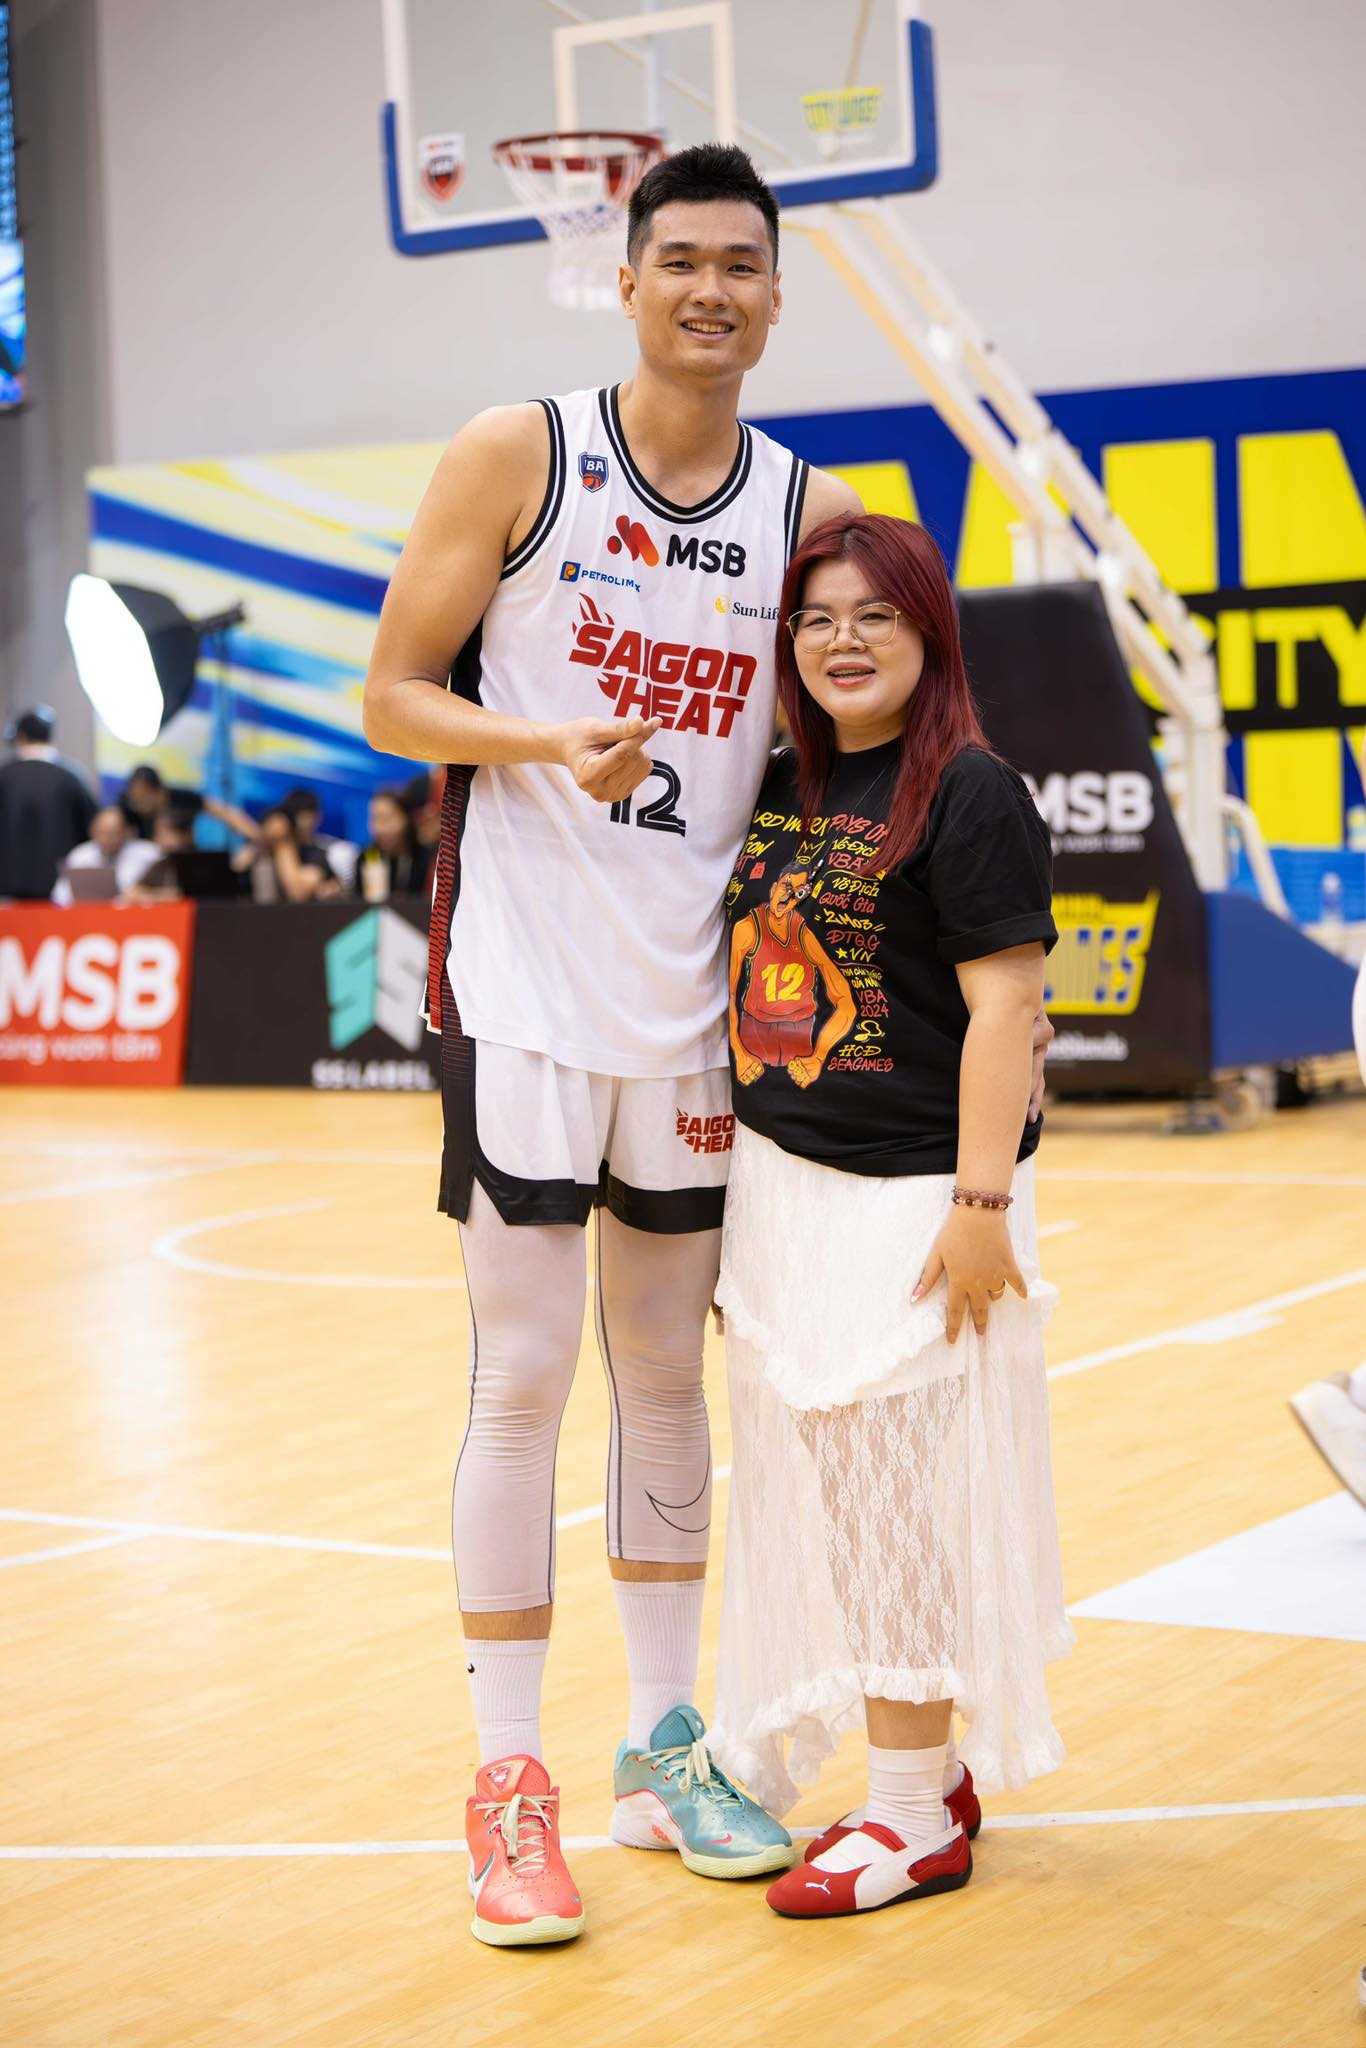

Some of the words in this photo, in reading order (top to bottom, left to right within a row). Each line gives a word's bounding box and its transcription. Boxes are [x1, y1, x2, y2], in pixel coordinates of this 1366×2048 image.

[584, 459, 605, 472] BA
[666, 534, 747, 578] MSB
[732, 601, 758, 617] Sun
[760, 606, 779, 620] Lif
[568, 622, 758, 697] SAIGON
[613, 675, 746, 739] HEAT
[828, 852, 865, 870] VBA
[849, 947, 877, 963] VN
[0, 934, 181, 1031] MSB
[761, 962, 806, 1003] 12
[855, 989, 888, 1004] VBA
[860, 1003, 889, 1019] 2024
[676, 1114, 737, 1137] SAIGO
[692, 1132, 737, 1154] HEA
